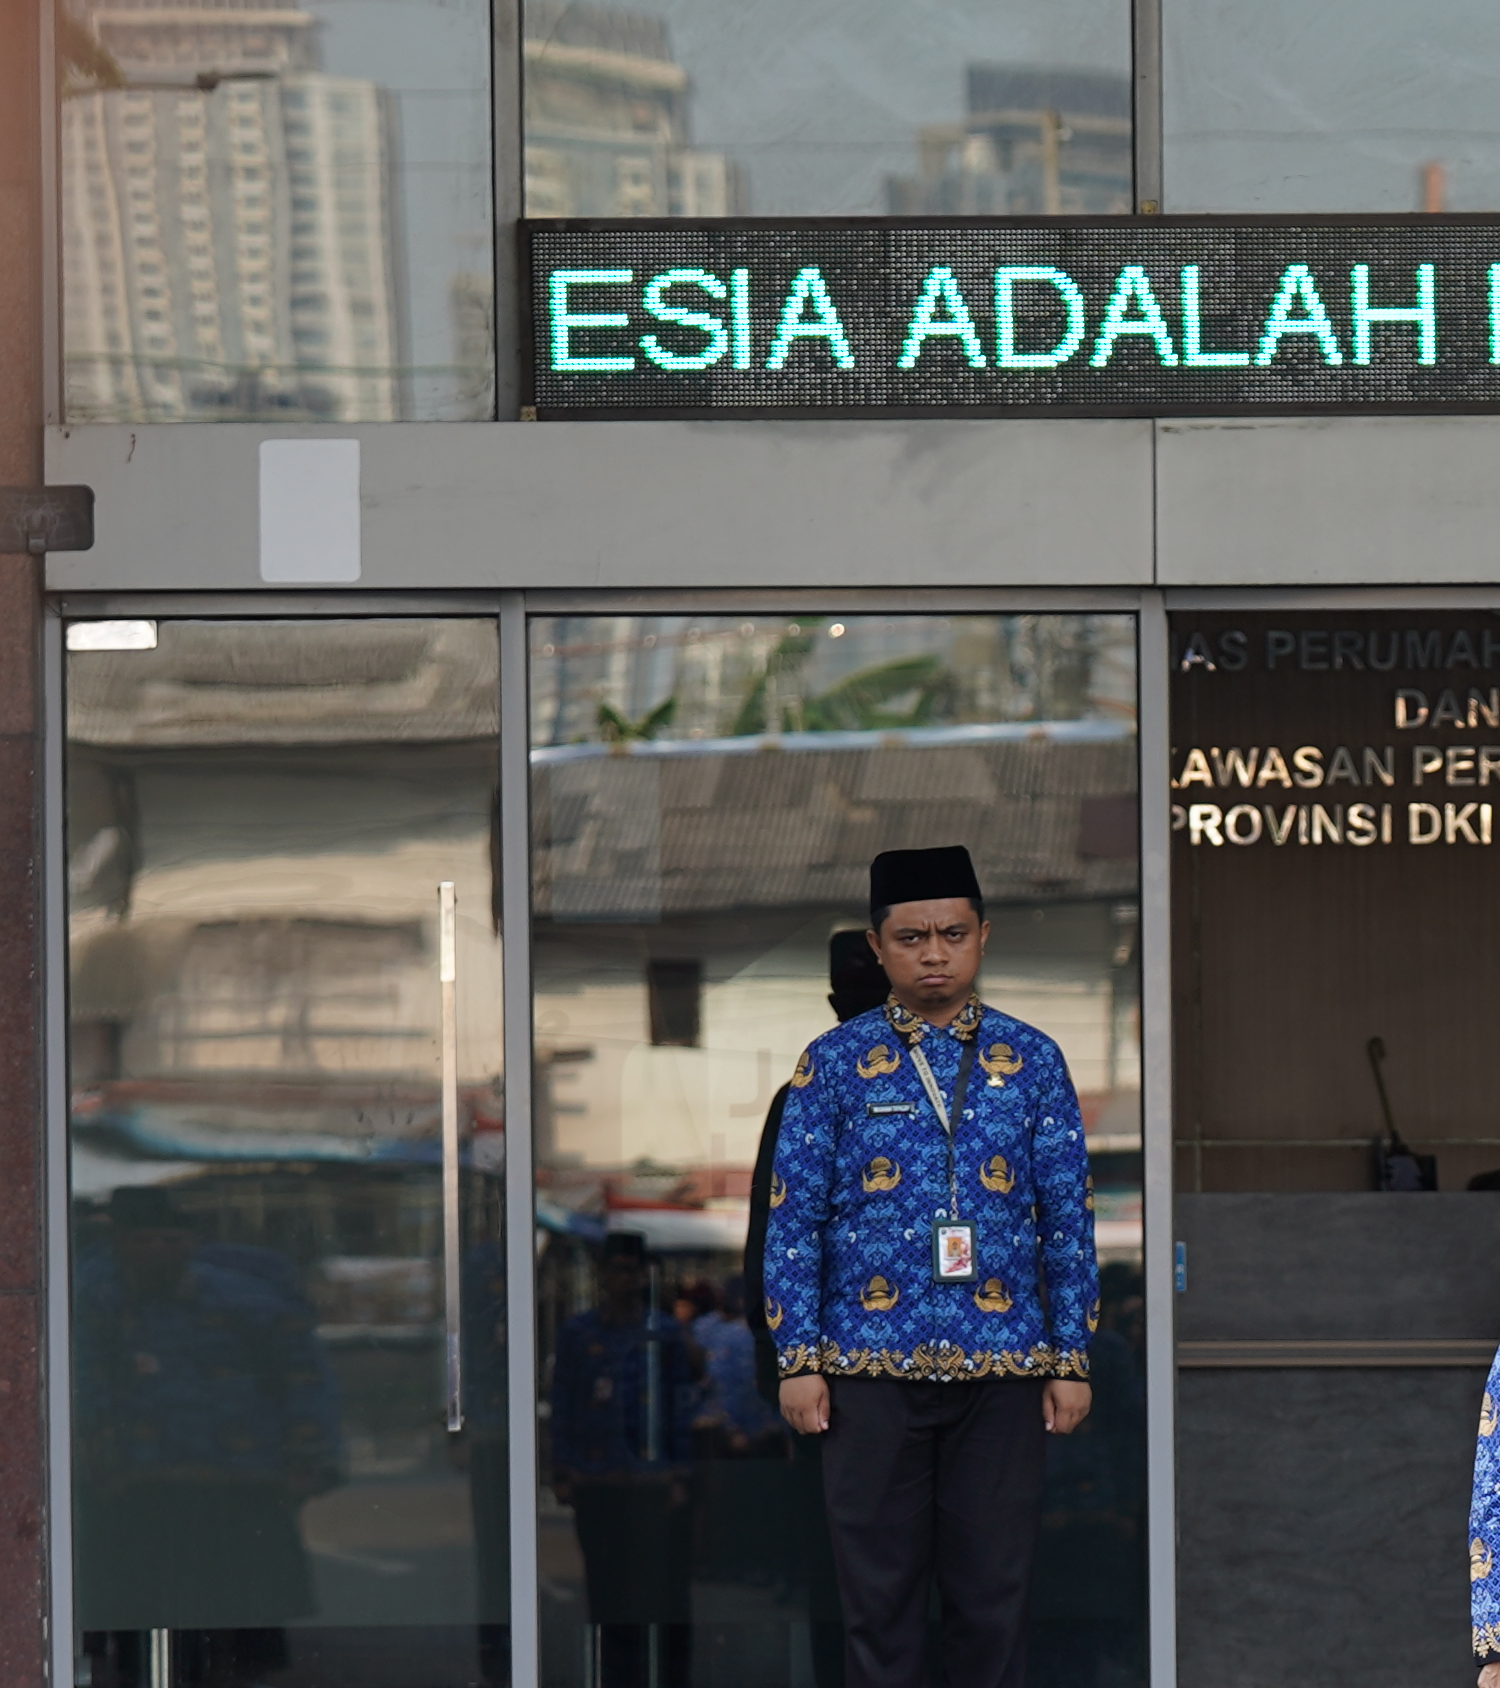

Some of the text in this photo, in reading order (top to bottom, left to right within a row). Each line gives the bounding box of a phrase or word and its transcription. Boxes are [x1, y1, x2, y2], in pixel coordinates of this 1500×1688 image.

[549, 268, 854, 371] ESIA
[897, 264, 1436, 368] ADALAH
[1170, 629, 1249, 672] AS
[1394, 687, 1500, 730] DAN
[1407, 801, 1493, 846] DKI
